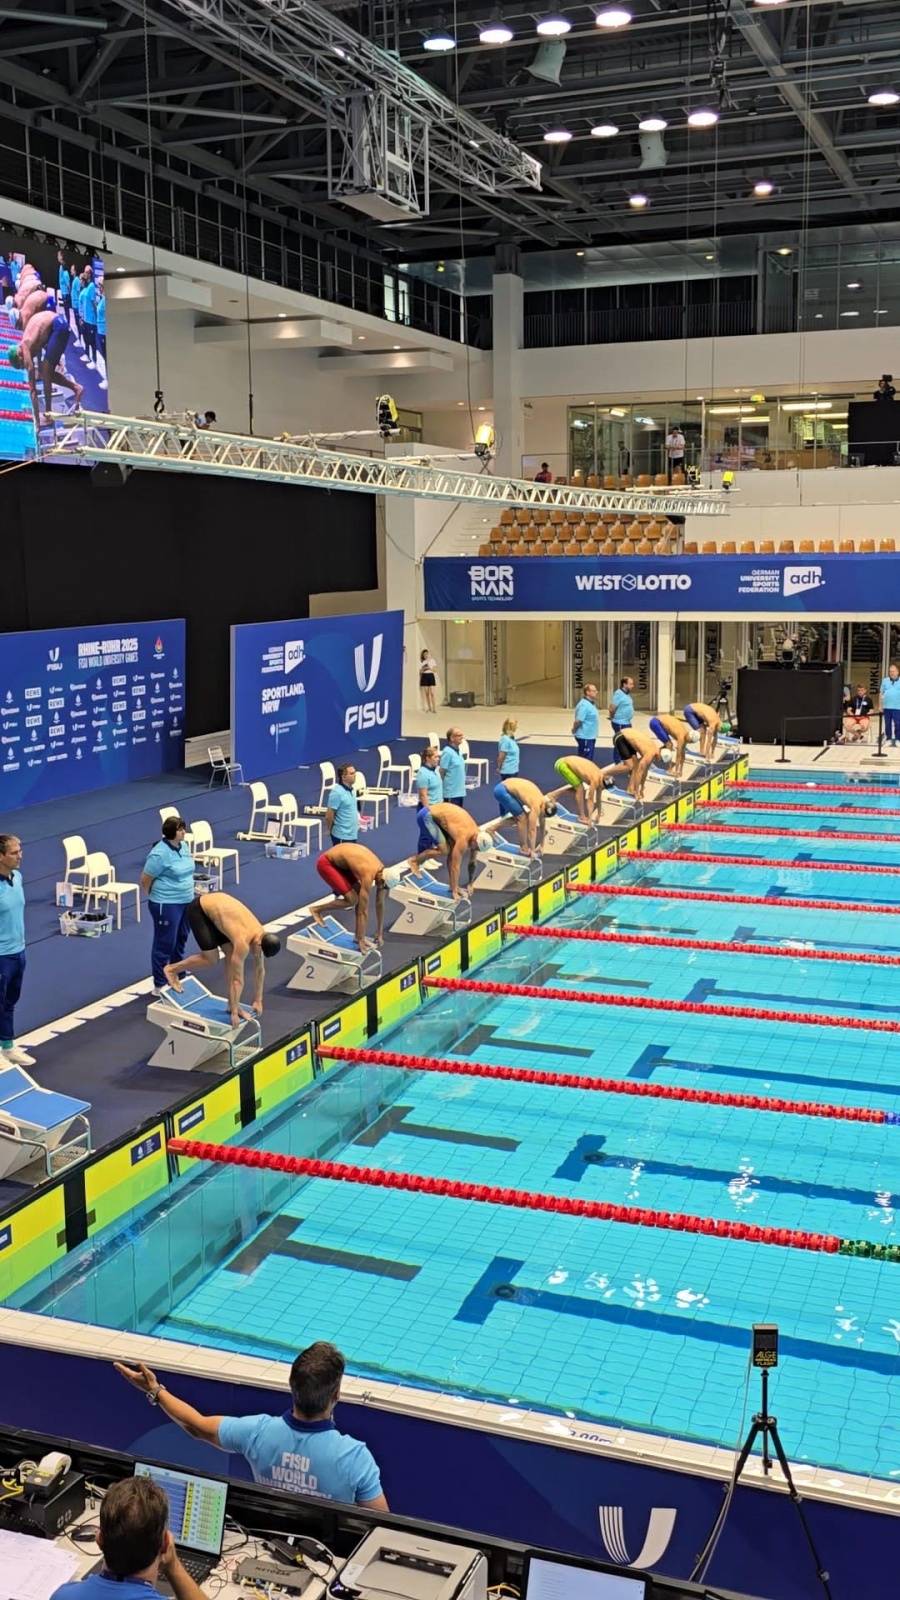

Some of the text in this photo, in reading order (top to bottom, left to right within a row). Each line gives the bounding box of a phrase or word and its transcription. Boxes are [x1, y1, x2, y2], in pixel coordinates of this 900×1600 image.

[467, 565, 514, 581] BOR
[471, 580, 514, 596] NAN
[121, 637, 138, 652] 2025
[575, 628, 584, 689] UMKLEIDEN
[262, 699, 280, 715] NRW
[344, 699, 389, 733] FISU
[548, 835, 555, 845] 5
[486, 869, 494, 880] 4
[406, 912, 414, 924] 3
[306, 965, 315, 979] 2
[168, 1040, 175, 1055] 1
[756, 1351, 777, 1359] ALGE
[281, 1451, 310, 1473] FISU
[271, 1465, 318, 1491] WORLD
[255, 1566, 291, 1576] NETGEAR
